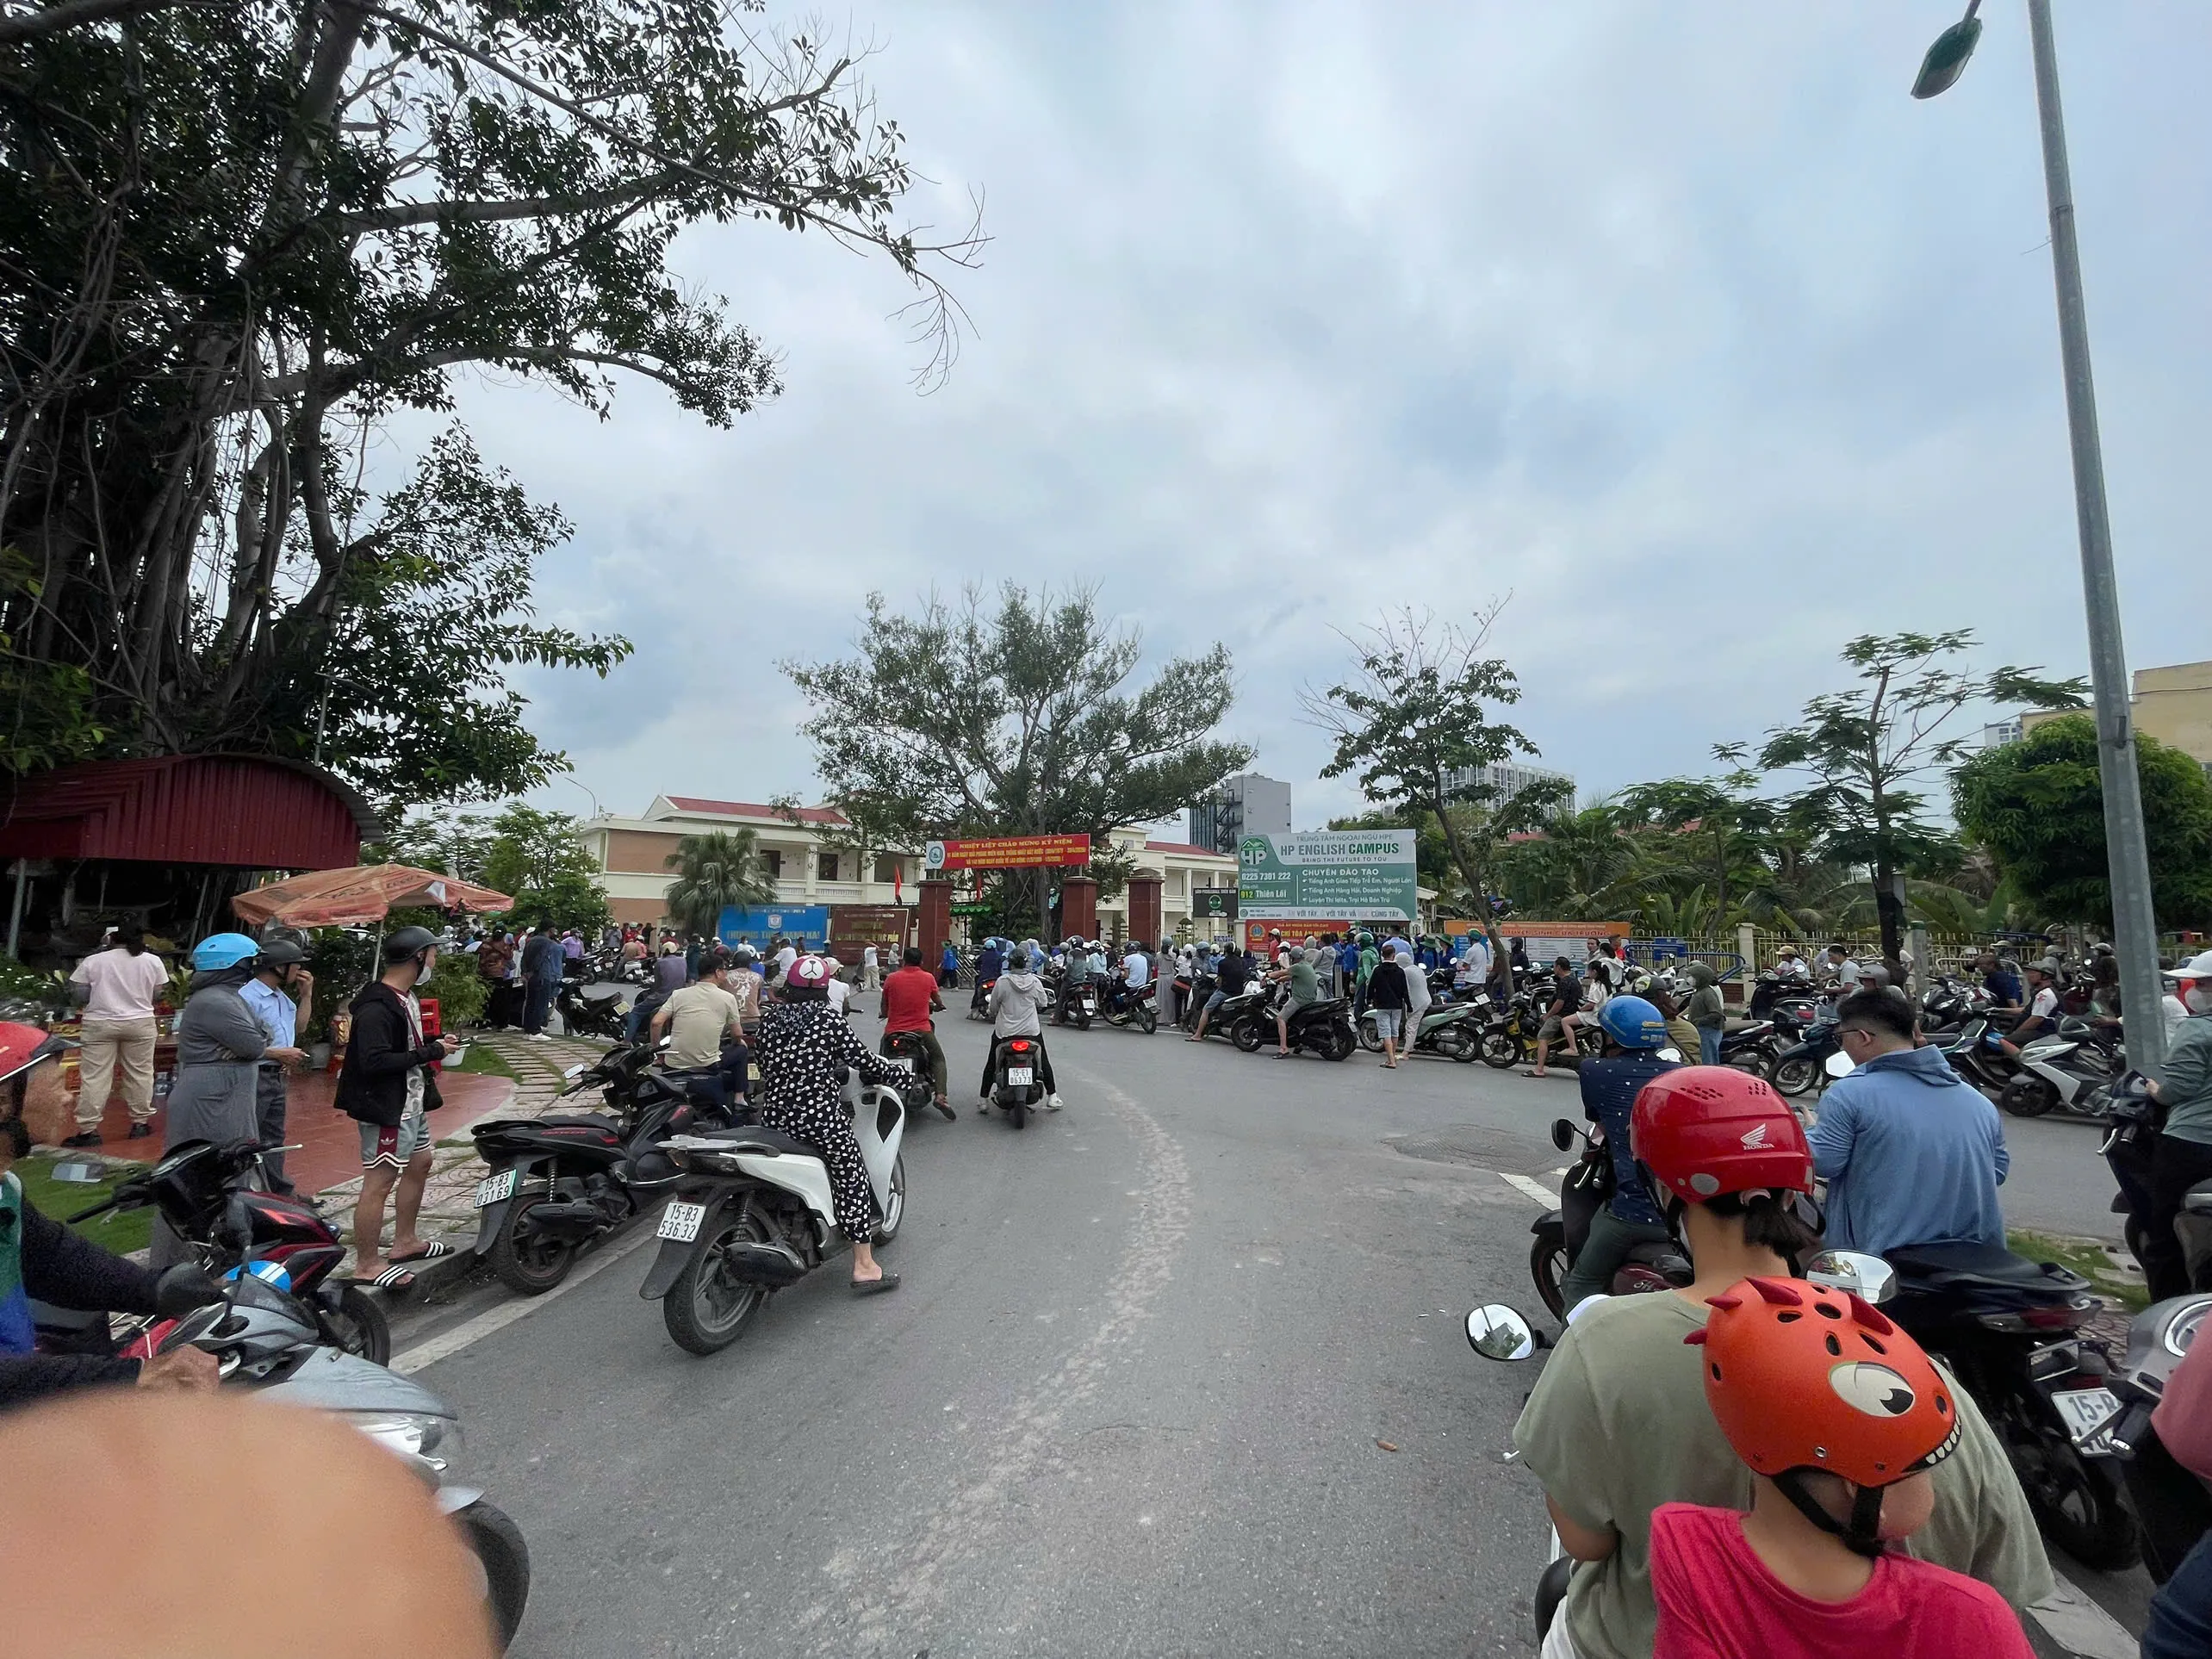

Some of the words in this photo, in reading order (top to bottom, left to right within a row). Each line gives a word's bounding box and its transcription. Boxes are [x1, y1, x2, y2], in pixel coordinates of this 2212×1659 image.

[1241, 849, 1267, 865] HP
[1280, 845, 1295, 856] HP
[1298, 844, 1345, 855] ENGLISH
[1348, 842, 1400, 854] CAMPUS
[1241, 873, 1258, 881] 0225
[1259, 872, 1275, 880] 7301
[1277, 872, 1291, 880] 222
[1339, 867, 1358, 876] ĐÀO
[484, 1172, 510, 1190] 15-B3
[669, 1203, 699, 1221] 15-B3
[659, 1220, 697, 1241] 536.32
